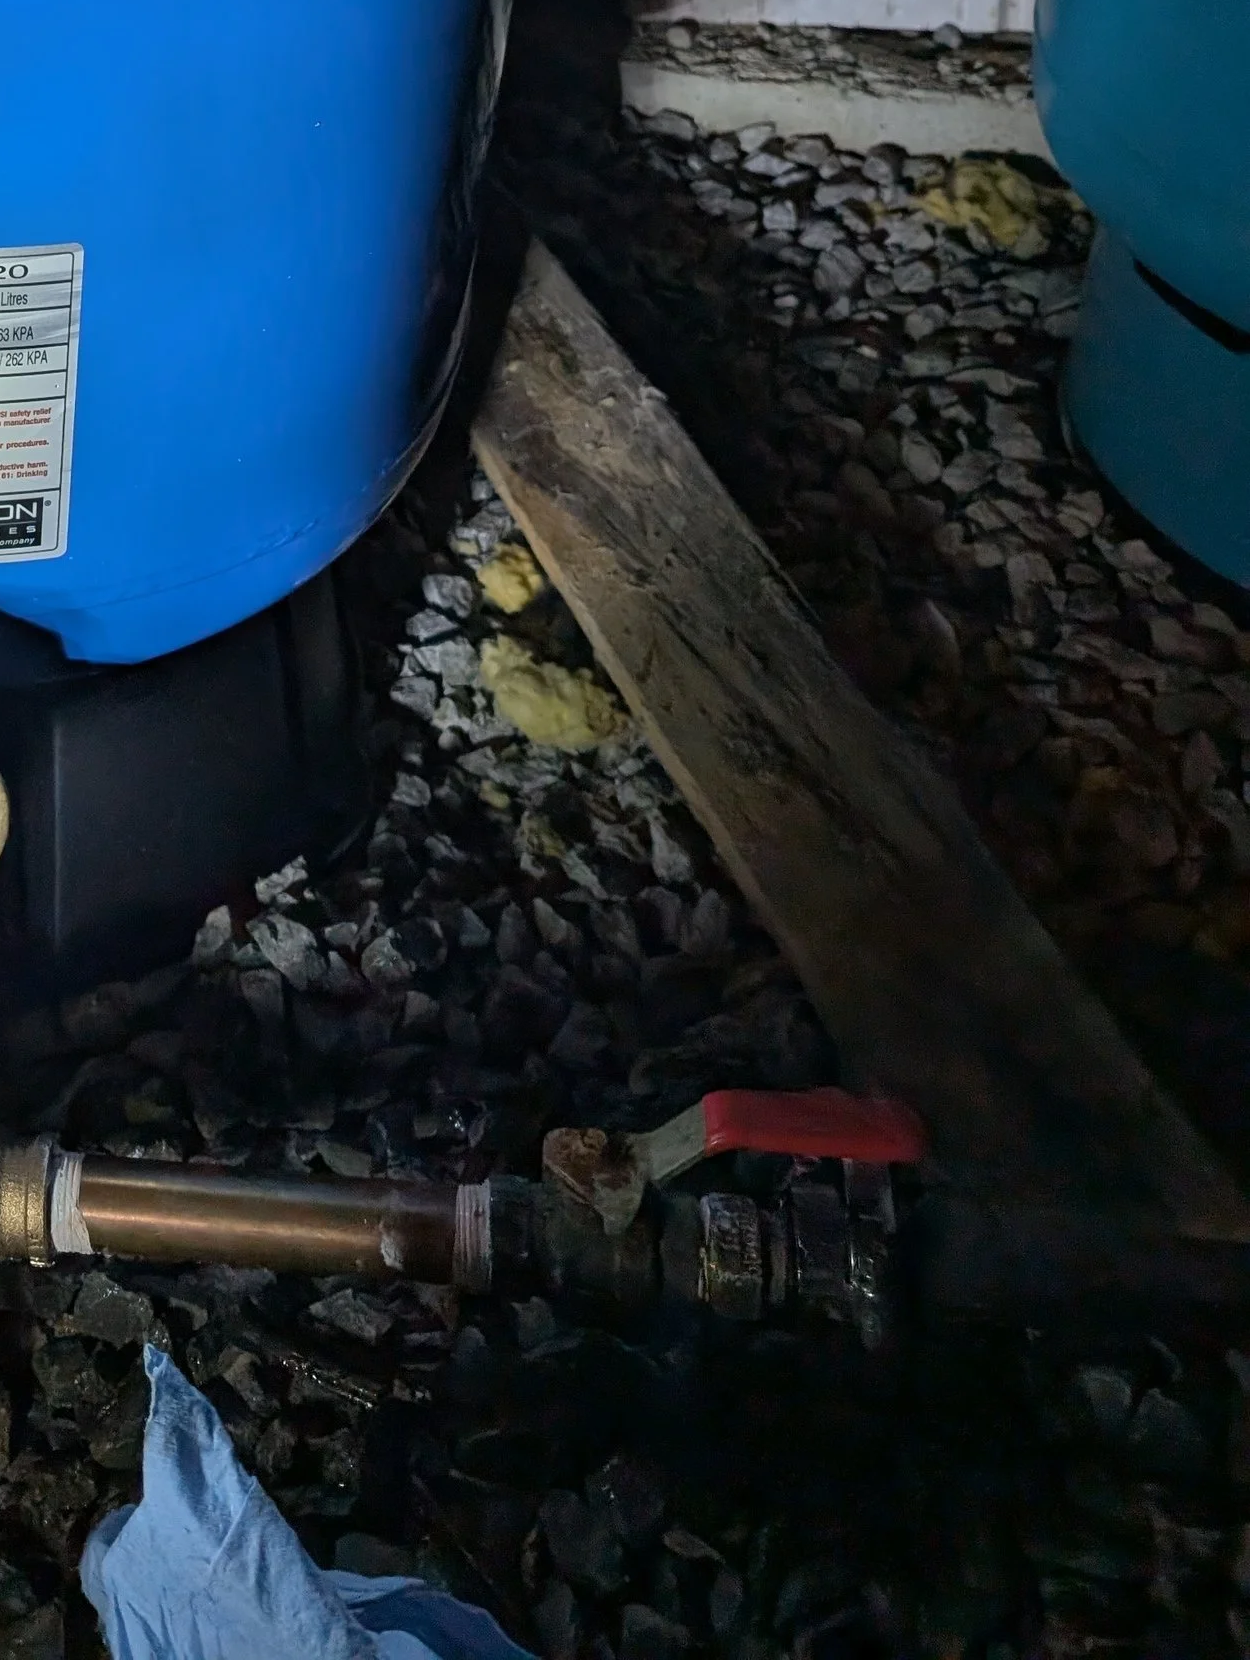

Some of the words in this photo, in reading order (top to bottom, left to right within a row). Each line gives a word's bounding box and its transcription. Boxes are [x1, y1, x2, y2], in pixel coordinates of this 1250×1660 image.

[1, 291, 28, 306] Litres
[12, 326, 34, 341] KPA
[5, 352, 24, 366] 262
[27, 350, 48, 365] KPA
